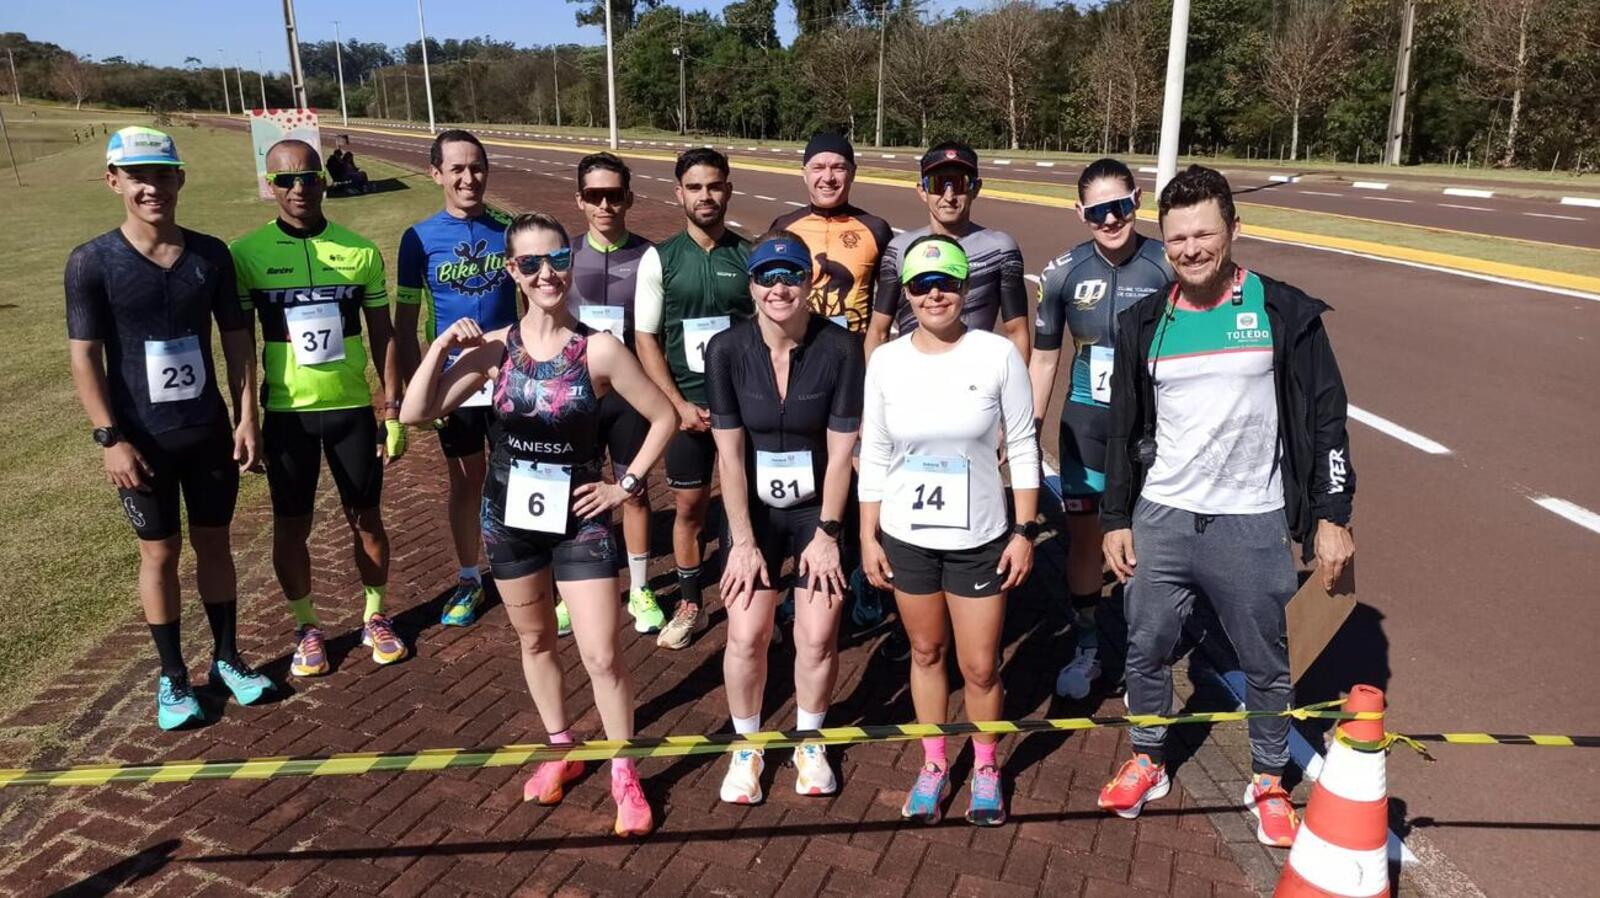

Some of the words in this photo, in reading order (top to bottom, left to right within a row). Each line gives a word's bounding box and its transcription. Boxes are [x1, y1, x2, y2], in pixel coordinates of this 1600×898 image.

[439, 256, 479, 283] Bike
[264, 285, 359, 304] TREK
[302, 328, 332, 353] 37
[1226, 329, 1269, 341] TOLEDO
[162, 363, 196, 390] 23
[508, 434, 574, 454] VANESSA
[770, 479, 800, 499] 81
[912, 483, 945, 511] 14
[528, 492, 545, 517] 6
